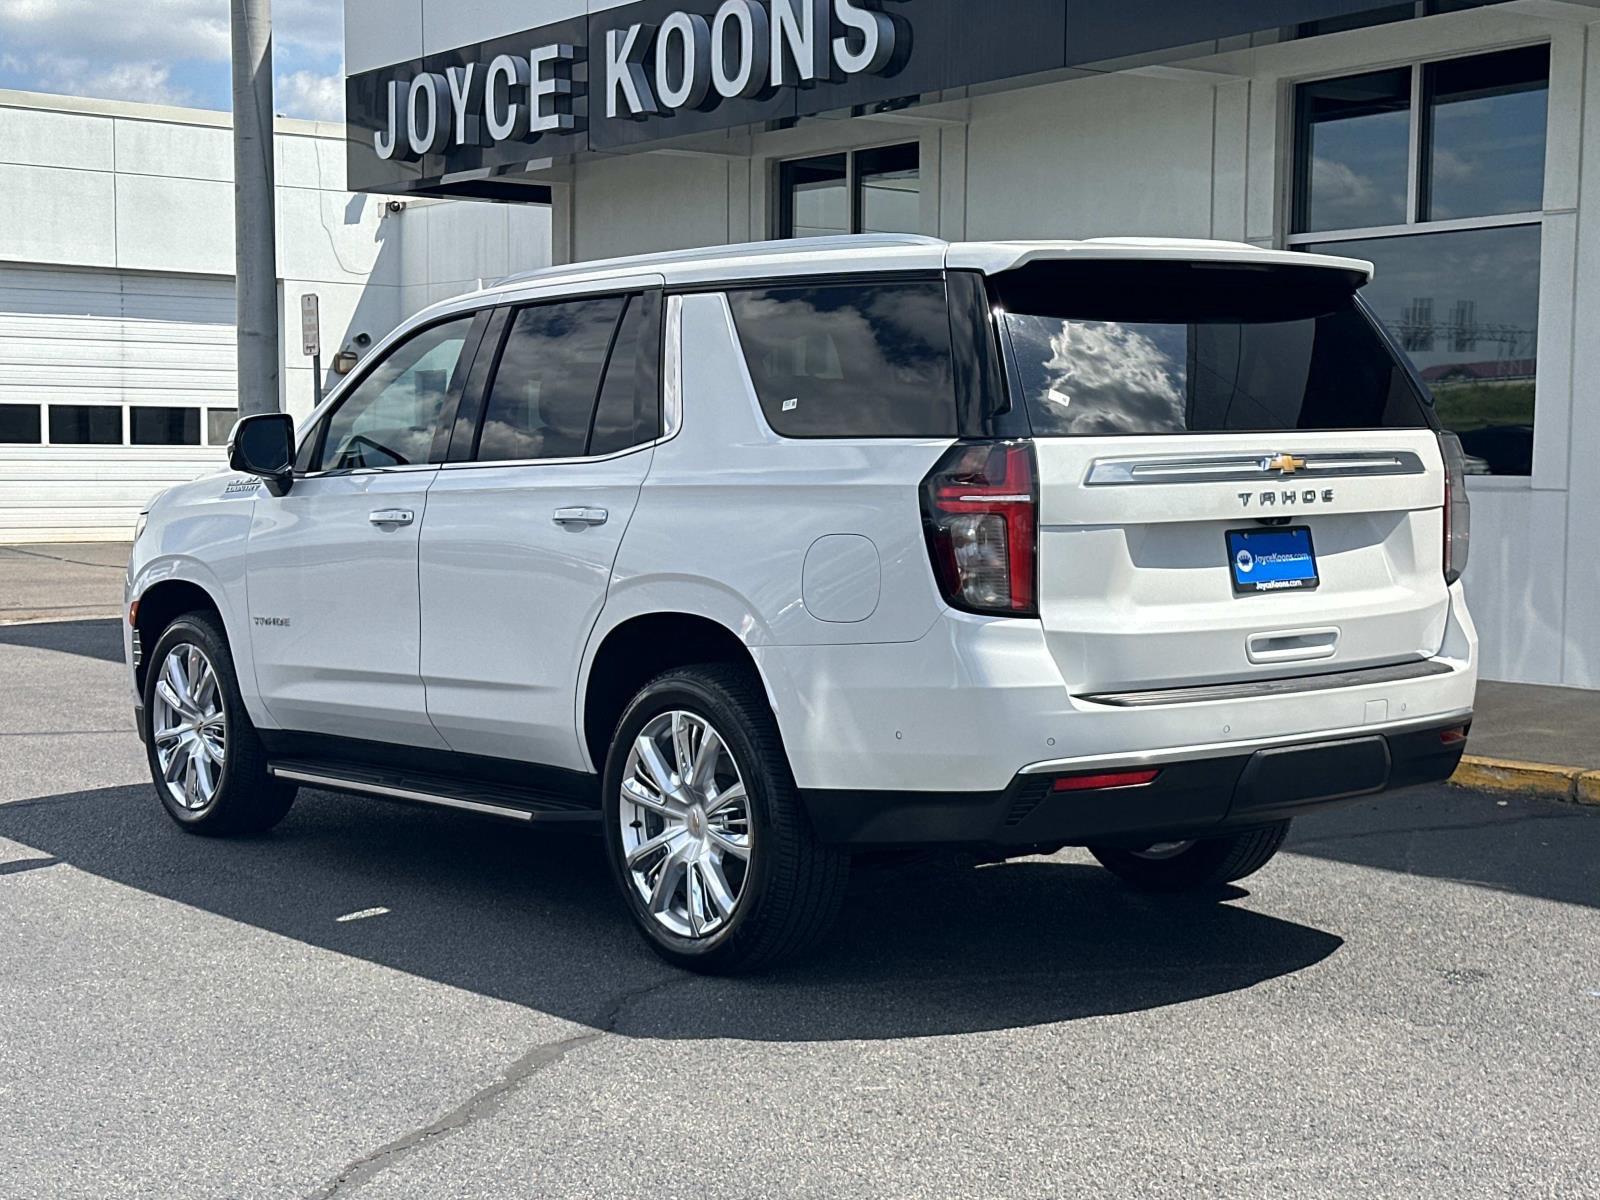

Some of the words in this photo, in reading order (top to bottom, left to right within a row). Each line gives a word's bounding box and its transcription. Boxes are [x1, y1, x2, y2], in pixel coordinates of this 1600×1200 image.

[374, 44, 572, 161] JOYCE
[606, 0, 893, 119] KOONS
[1238, 489, 1334, 506] TAHOE
[1254, 552, 1309, 566] JoyceKoons.com
